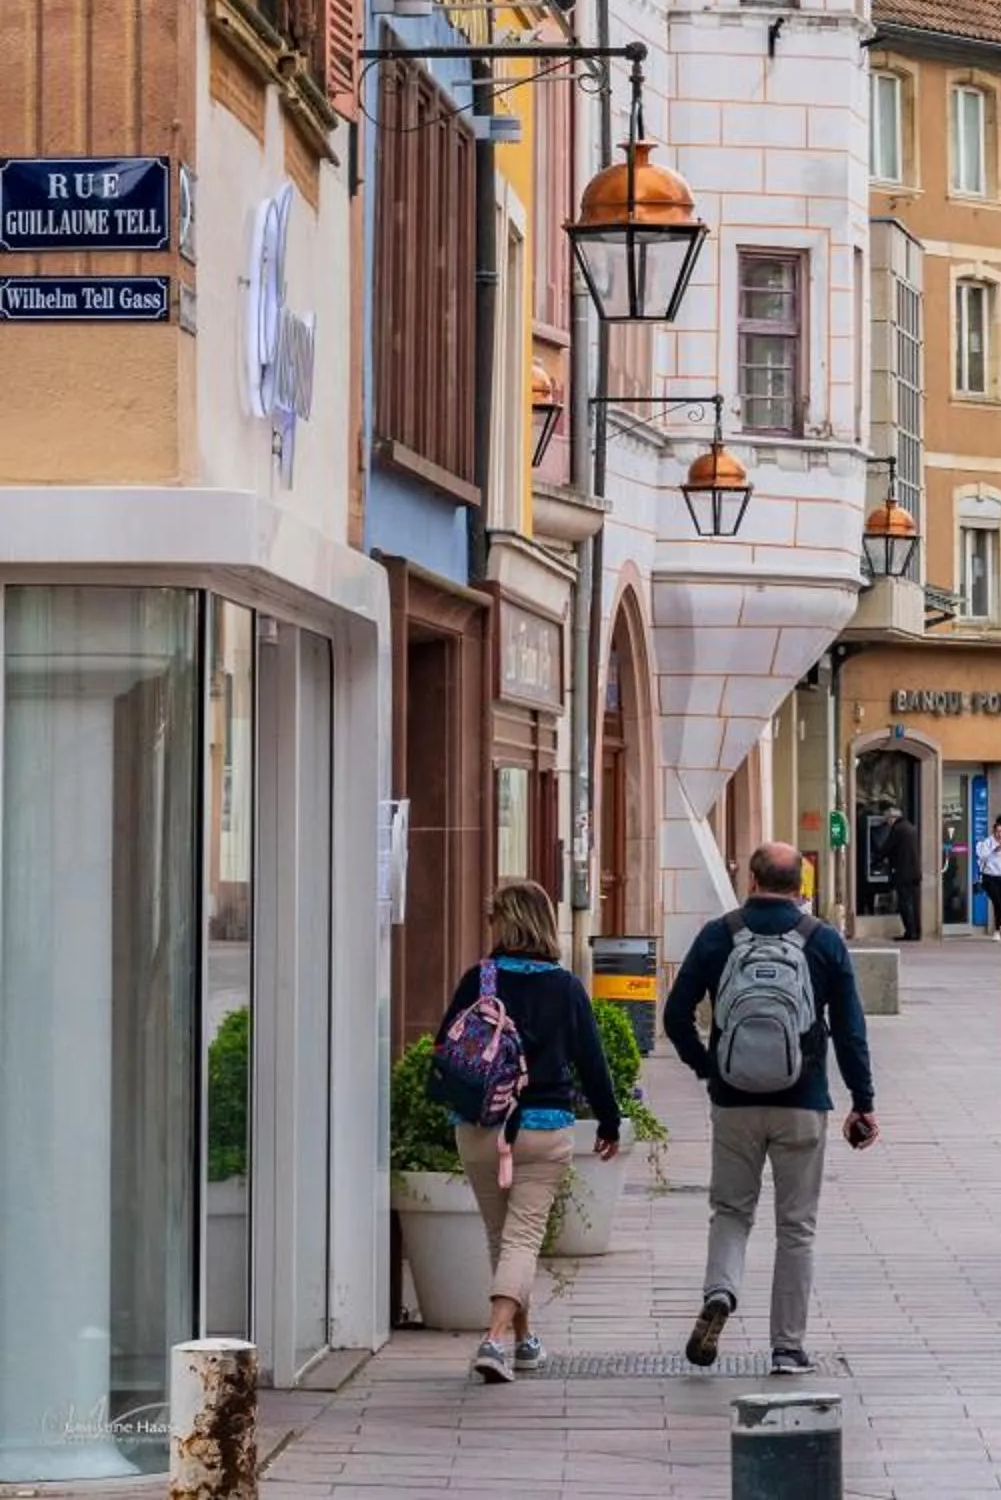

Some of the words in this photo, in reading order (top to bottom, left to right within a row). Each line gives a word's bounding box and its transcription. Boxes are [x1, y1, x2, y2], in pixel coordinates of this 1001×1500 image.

[47, 173, 120, 199] RUE
[5, 209, 110, 236] GUILLAUME
[114, 209, 162, 235] TELL
[7, 287, 77, 309] Wilhelm
[82, 288, 114, 309] Tell
[119, 288, 161, 309] Gass
